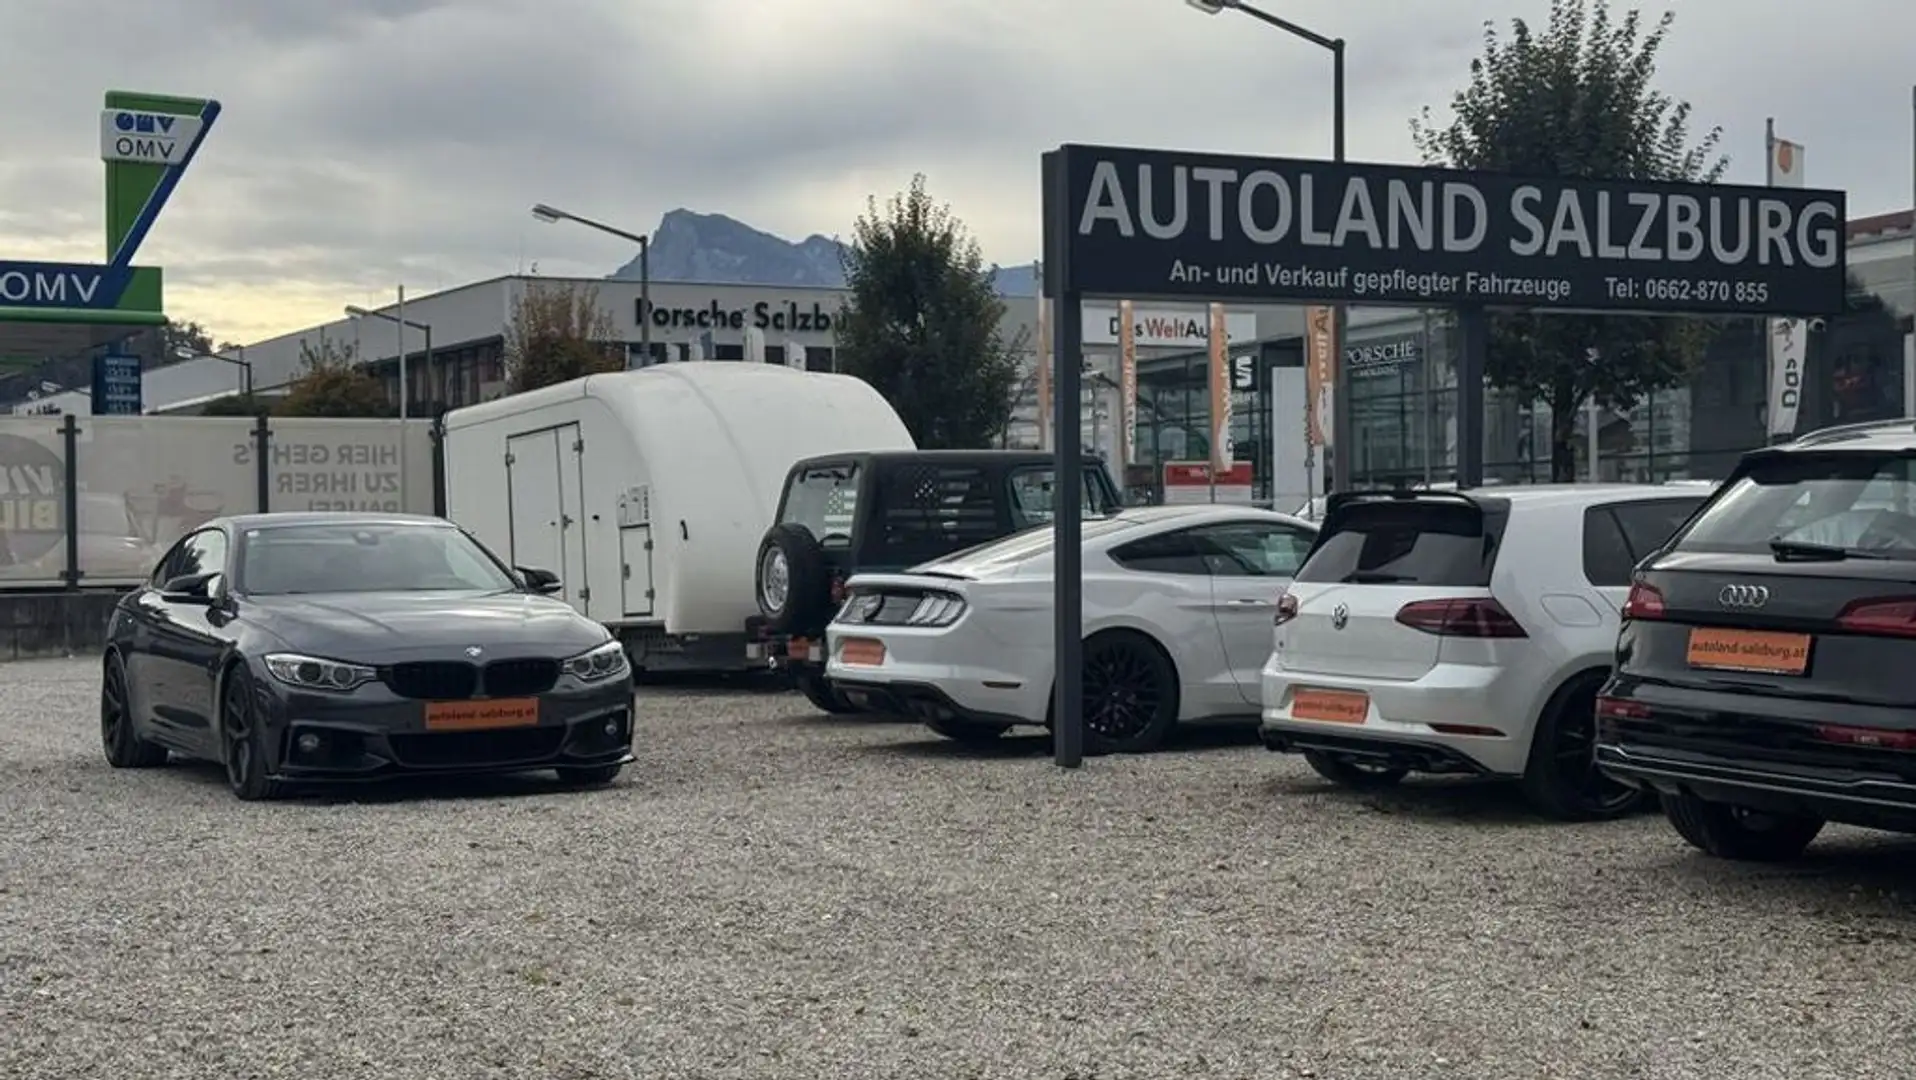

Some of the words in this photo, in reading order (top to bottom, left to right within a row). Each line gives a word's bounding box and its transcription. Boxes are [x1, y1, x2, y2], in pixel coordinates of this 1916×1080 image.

[115, 137, 175, 159] OMV
[1079, 161, 1487, 252] AUTOLAND
[1510, 185, 1837, 267] SALZBURG
[1, 271, 101, 303] OMV
[1169, 259, 1211, 283] An-
[1217, 263, 1259, 285] und
[1265, 263, 1348, 288] Verkauf
[1353, 269, 1460, 295] gepflegter
[1466, 271, 1571, 300] Fahrzeuge
[1605, 277, 1639, 299] Tel:
[1645, 278, 1730, 302] 0662-870
[1735, 282, 1769, 303] 855
[635, 297, 744, 330] Porsche
[1109, 315, 1232, 340] DsWeltAu.
